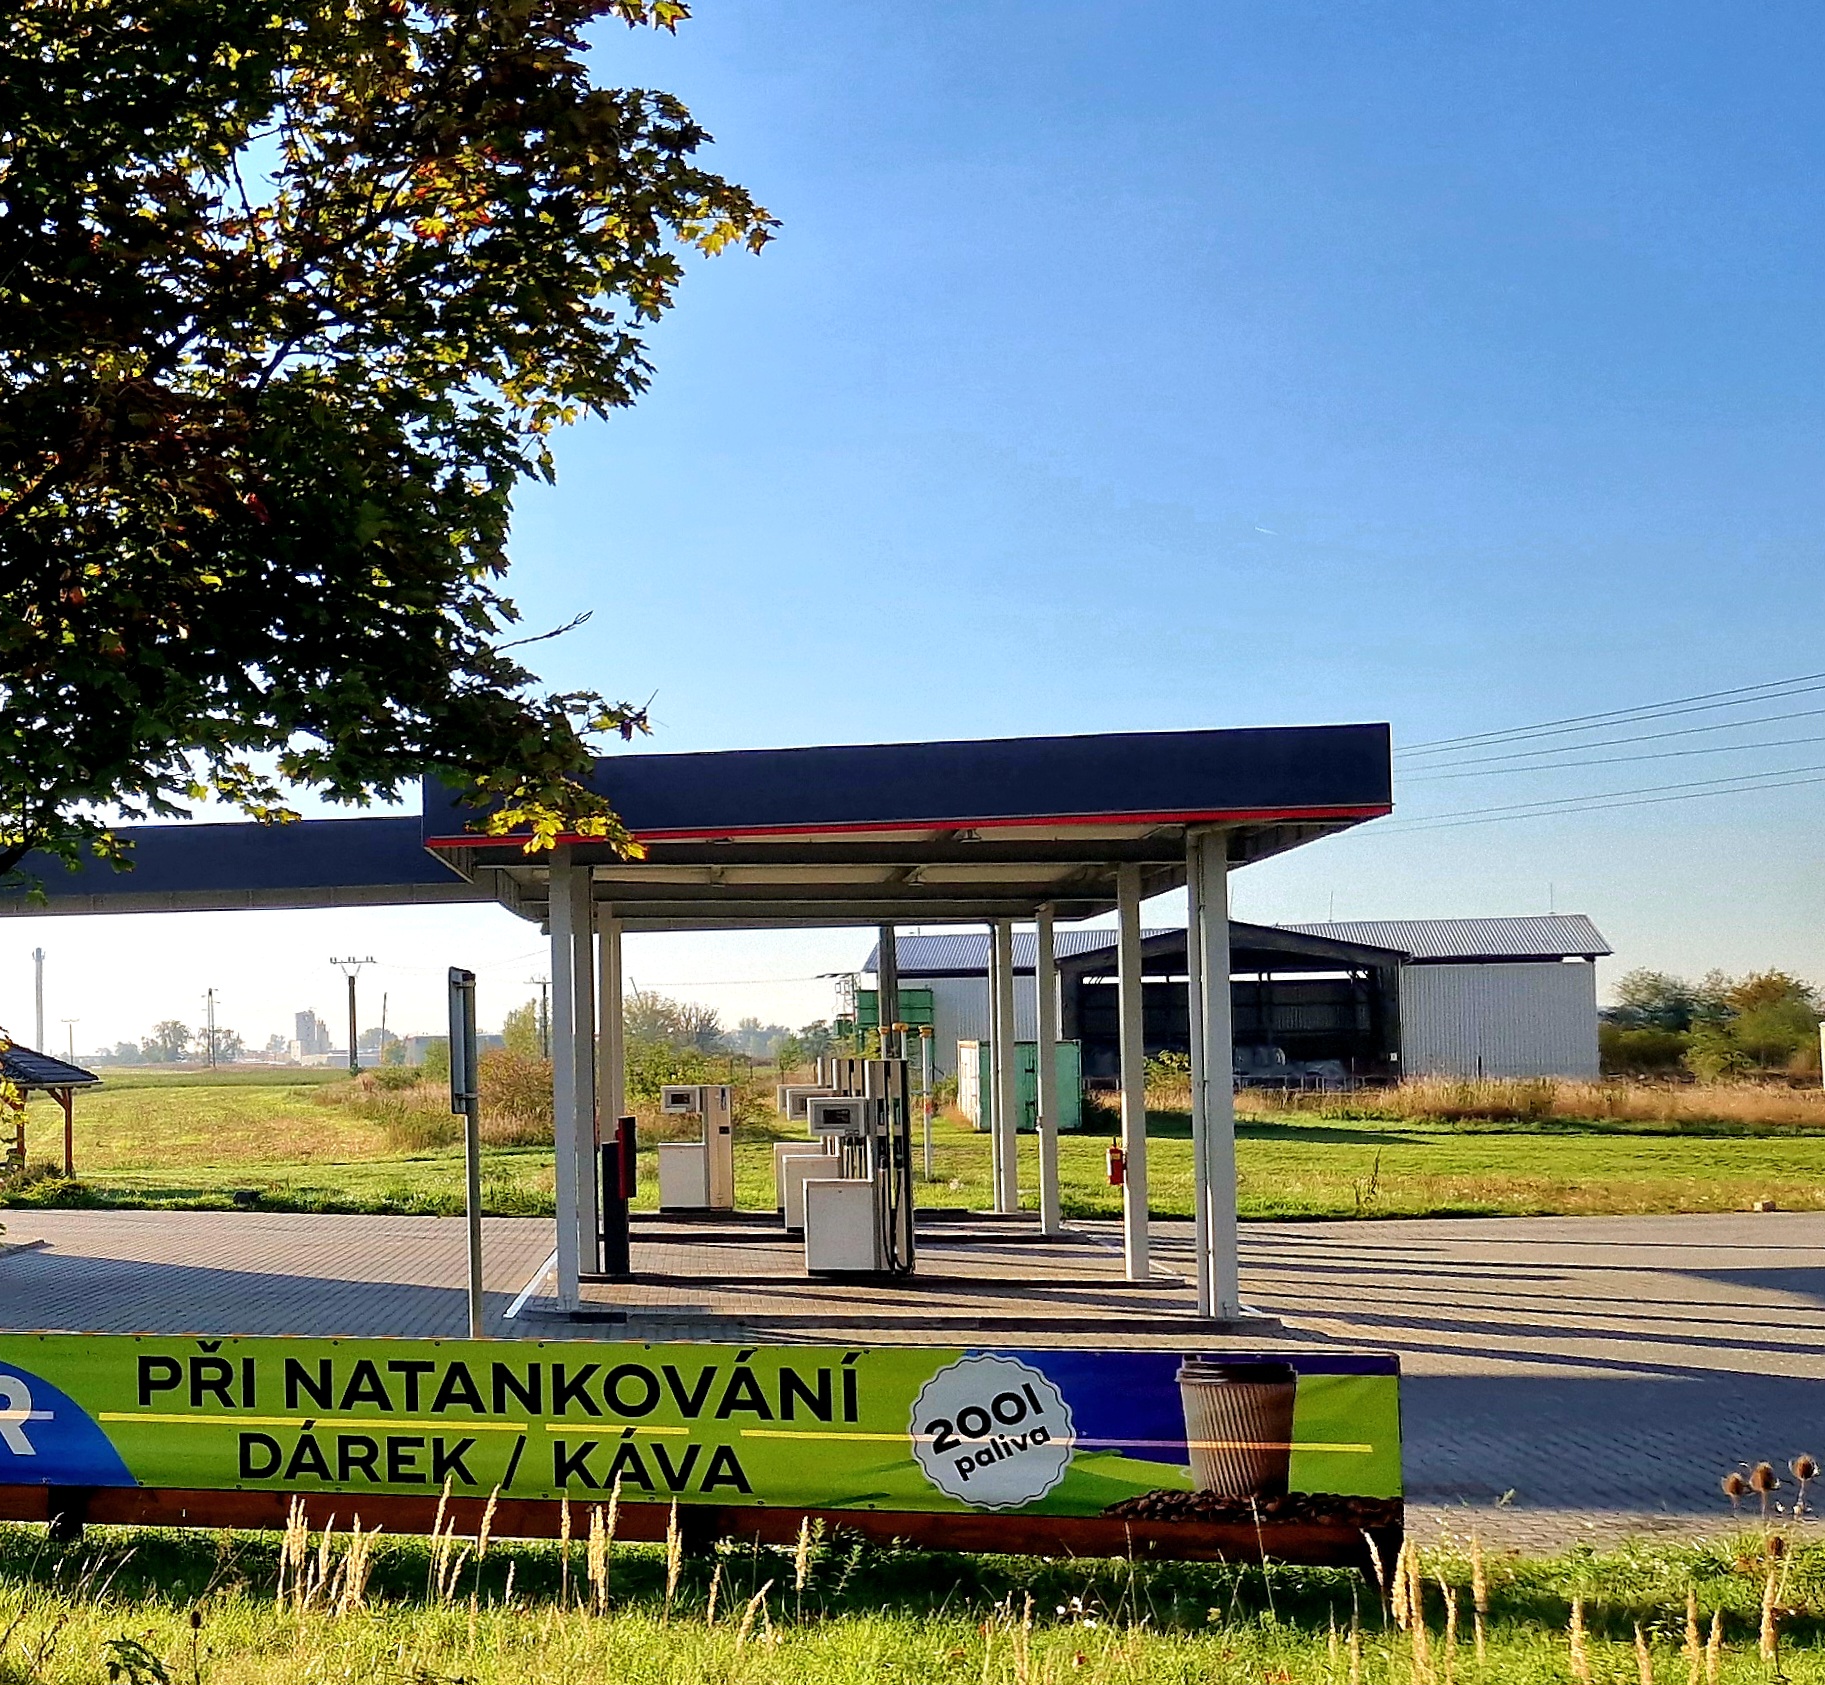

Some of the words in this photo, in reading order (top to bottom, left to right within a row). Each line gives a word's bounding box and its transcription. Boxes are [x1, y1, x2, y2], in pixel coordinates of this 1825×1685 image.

[137, 1340, 256, 1408] PŘI
[284, 1346, 862, 1423] NATANKOVÁNÍ
[239, 1419, 479, 1487] DÁREK
[497, 1434, 527, 1492] /
[553, 1427, 754, 1495] KÁVA
[953, 1424, 1052, 1482] paliva
